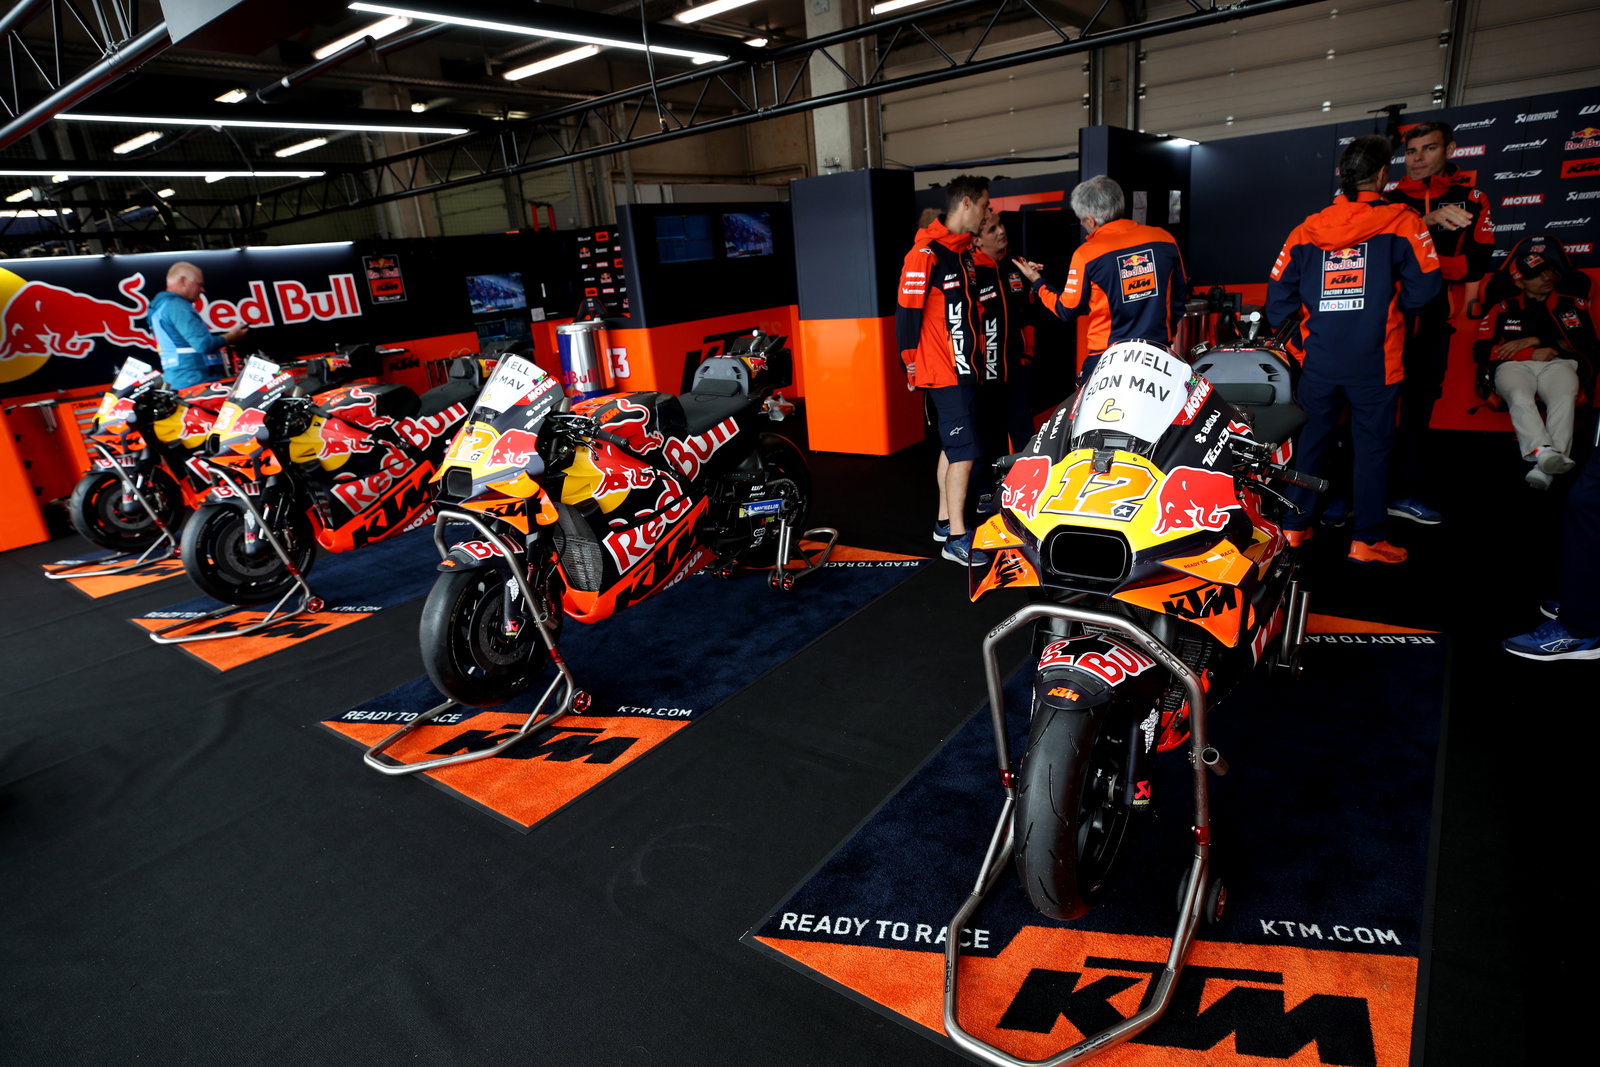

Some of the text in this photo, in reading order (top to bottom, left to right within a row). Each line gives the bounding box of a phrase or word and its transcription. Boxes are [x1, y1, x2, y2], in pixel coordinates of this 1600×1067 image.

[1502, 195, 1542, 206] MOTUL
[1325, 258, 1364, 272] Red Bull
[1330, 273, 1359, 285] KTM
[1128, 278, 1151, 291] KTM
[1323, 287, 1363, 296] FACTORY RACING
[274, 273, 362, 325] Bull
[1320, 301, 1350, 311] Mobil
[1123, 349, 1172, 377] WELL
[500, 375, 525, 391] MAV
[527, 379, 559, 402] MOTUL
[1128, 375, 1170, 401] MAV
[1183, 380, 1211, 420] MOTUL
[391, 402, 469, 451] Bull
[661, 416, 741, 482] Bull
[1202, 426, 1232, 468] TECH3
[330, 439, 417, 516] Red
[1040, 459, 1157, 523] 12
[403, 505, 436, 533] MOTU
[602, 467, 694, 576] Red
[1161, 582, 1238, 620] KTM
[1073, 635, 1157, 687] Bull
[1047, 686, 1081, 702] KTM
[342, 711, 397, 721] READY
[617, 705, 692, 717] KTM.COM
[779, 912, 869, 937] READY
[875, 919, 910, 941] TO
[1260, 919, 1402, 946] KTM.COM
[996, 956, 1378, 1067] KTM
